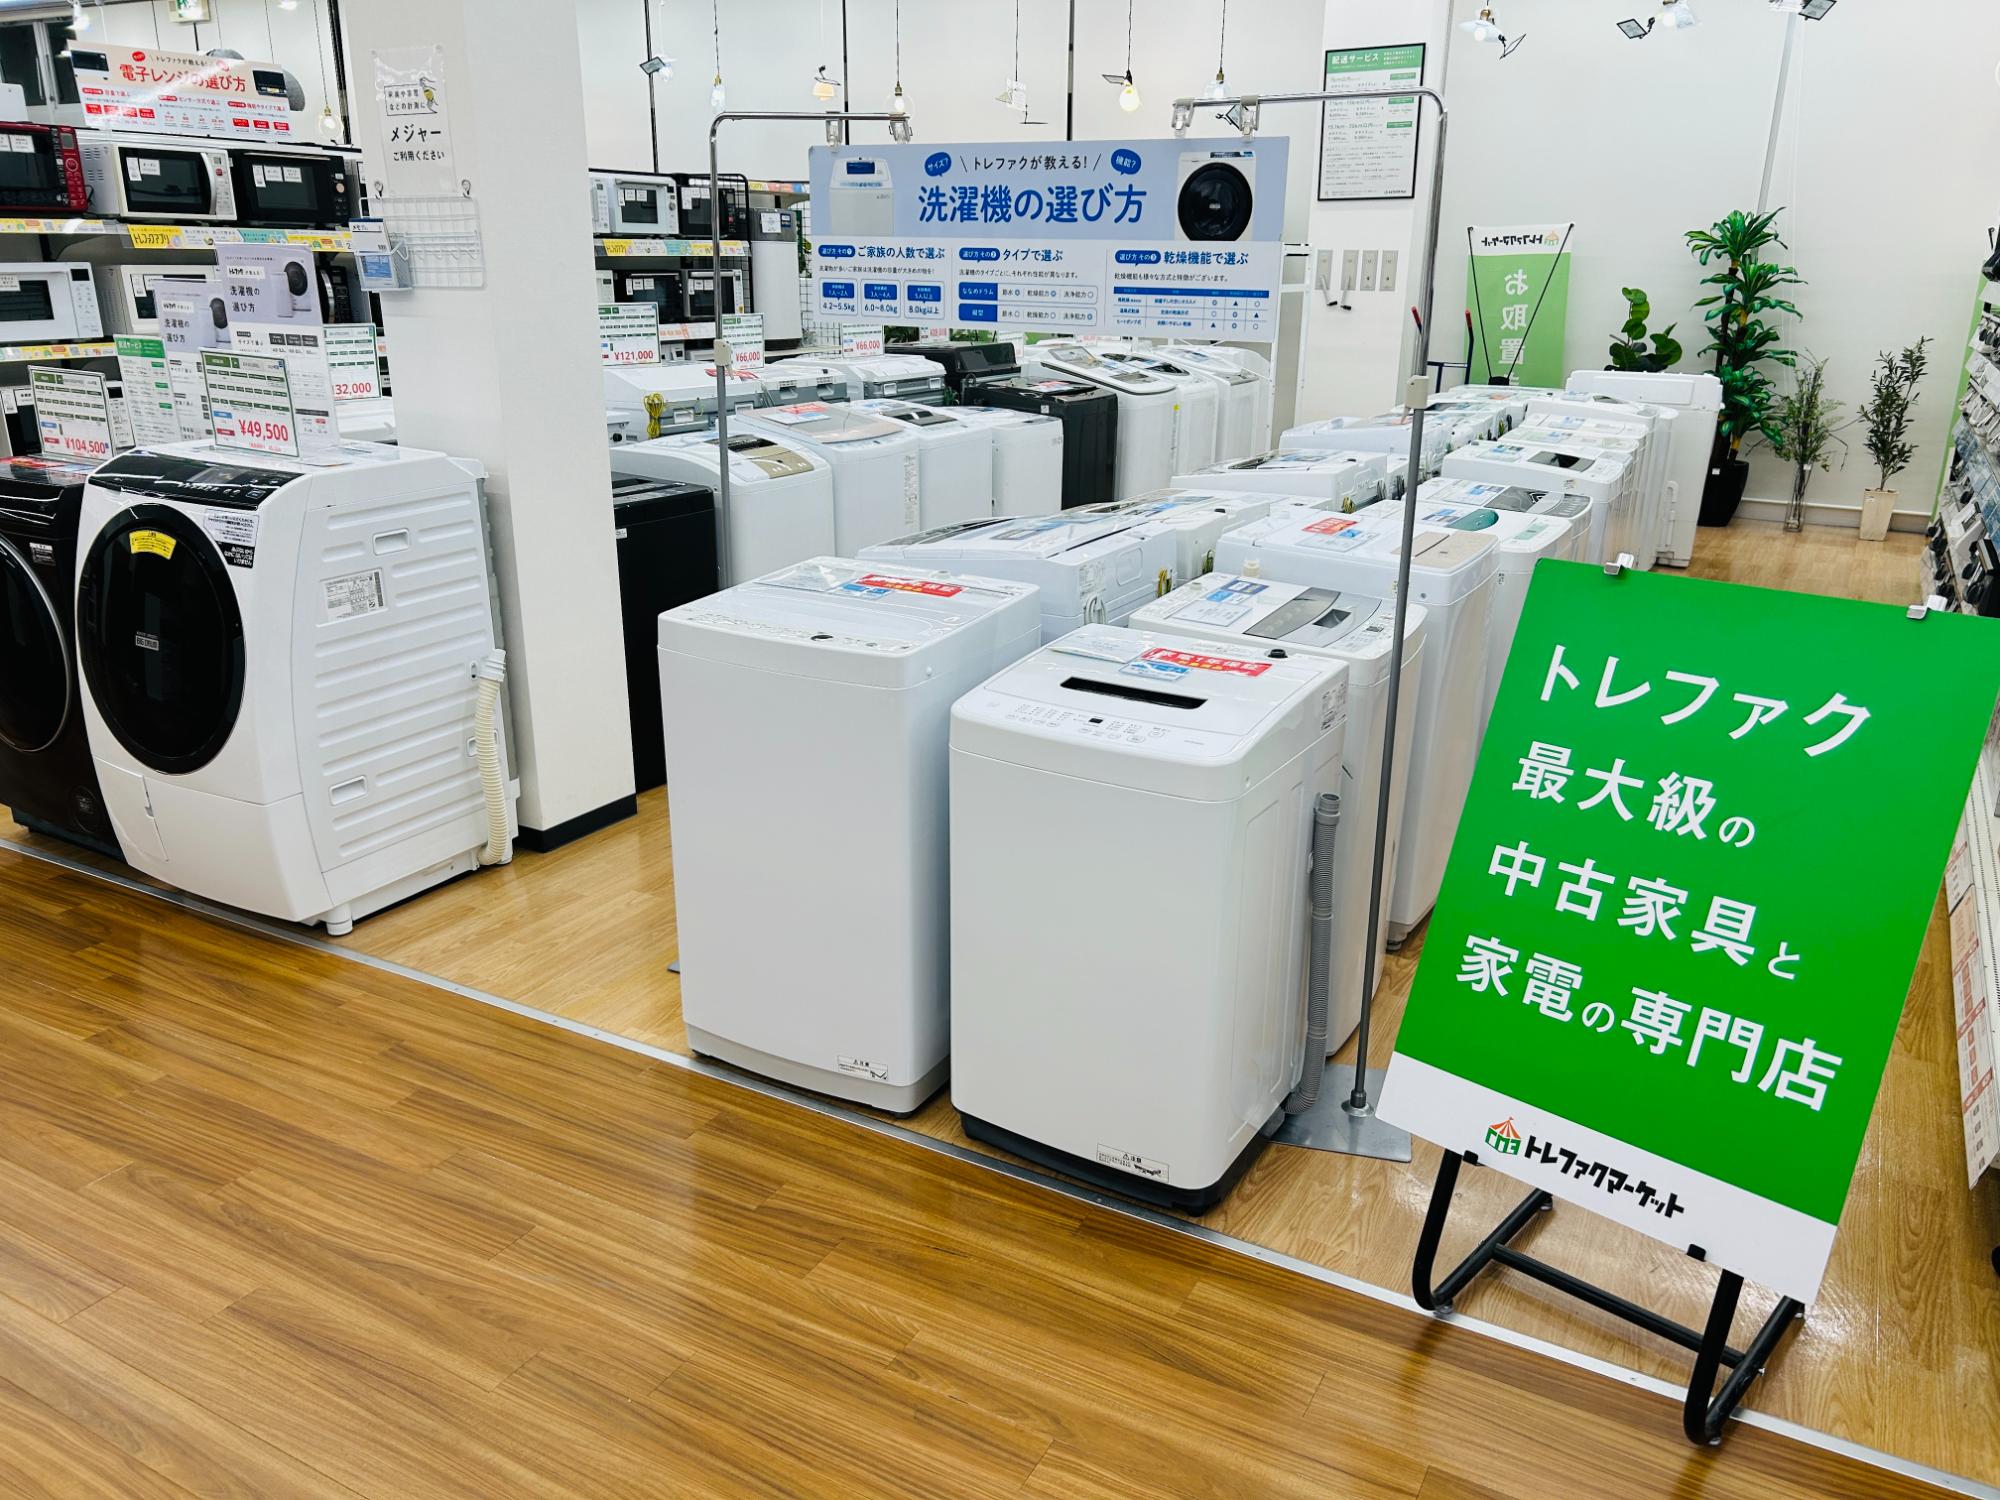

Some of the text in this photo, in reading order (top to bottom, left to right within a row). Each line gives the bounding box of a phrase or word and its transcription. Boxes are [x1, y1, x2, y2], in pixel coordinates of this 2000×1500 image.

[1331, 52, 1379, 65] 配送サービス
[119, 63, 246, 93] 電子レンジの選び方
[391, 123, 442, 143] メジャー
[393, 149, 446, 162] ご利用ください
[974, 155, 1088, 171] トレファクが教える!
[918, 182, 1148, 225] 洗濯機の選び方
[858, 245, 946, 260] ご家族の人数で選ぶ
[1003, 248, 1064, 262] タイプで選ぶ
[1163, 250, 1249, 265] 乾燥機能で選ぶ
[229, 285, 261, 297] 洗濯機の
[232, 302, 256, 313] 選び方
[614, 350, 654, 361] ¥121,000
[735, 351, 761, 362] ¥66,000
[238, 419, 289, 442] ¥49,500
[64, 437, 106, 454] ¥104,500
[1540, 644, 1871, 758] トレファク
[1511, 741, 1756, 849] 最大級の
[1487, 840, 1804, 982] 中古家具と
[1456, 934, 1844, 1112] 家電の専門店
[1523, 1135, 1685, 1220] トレファクマーケット
